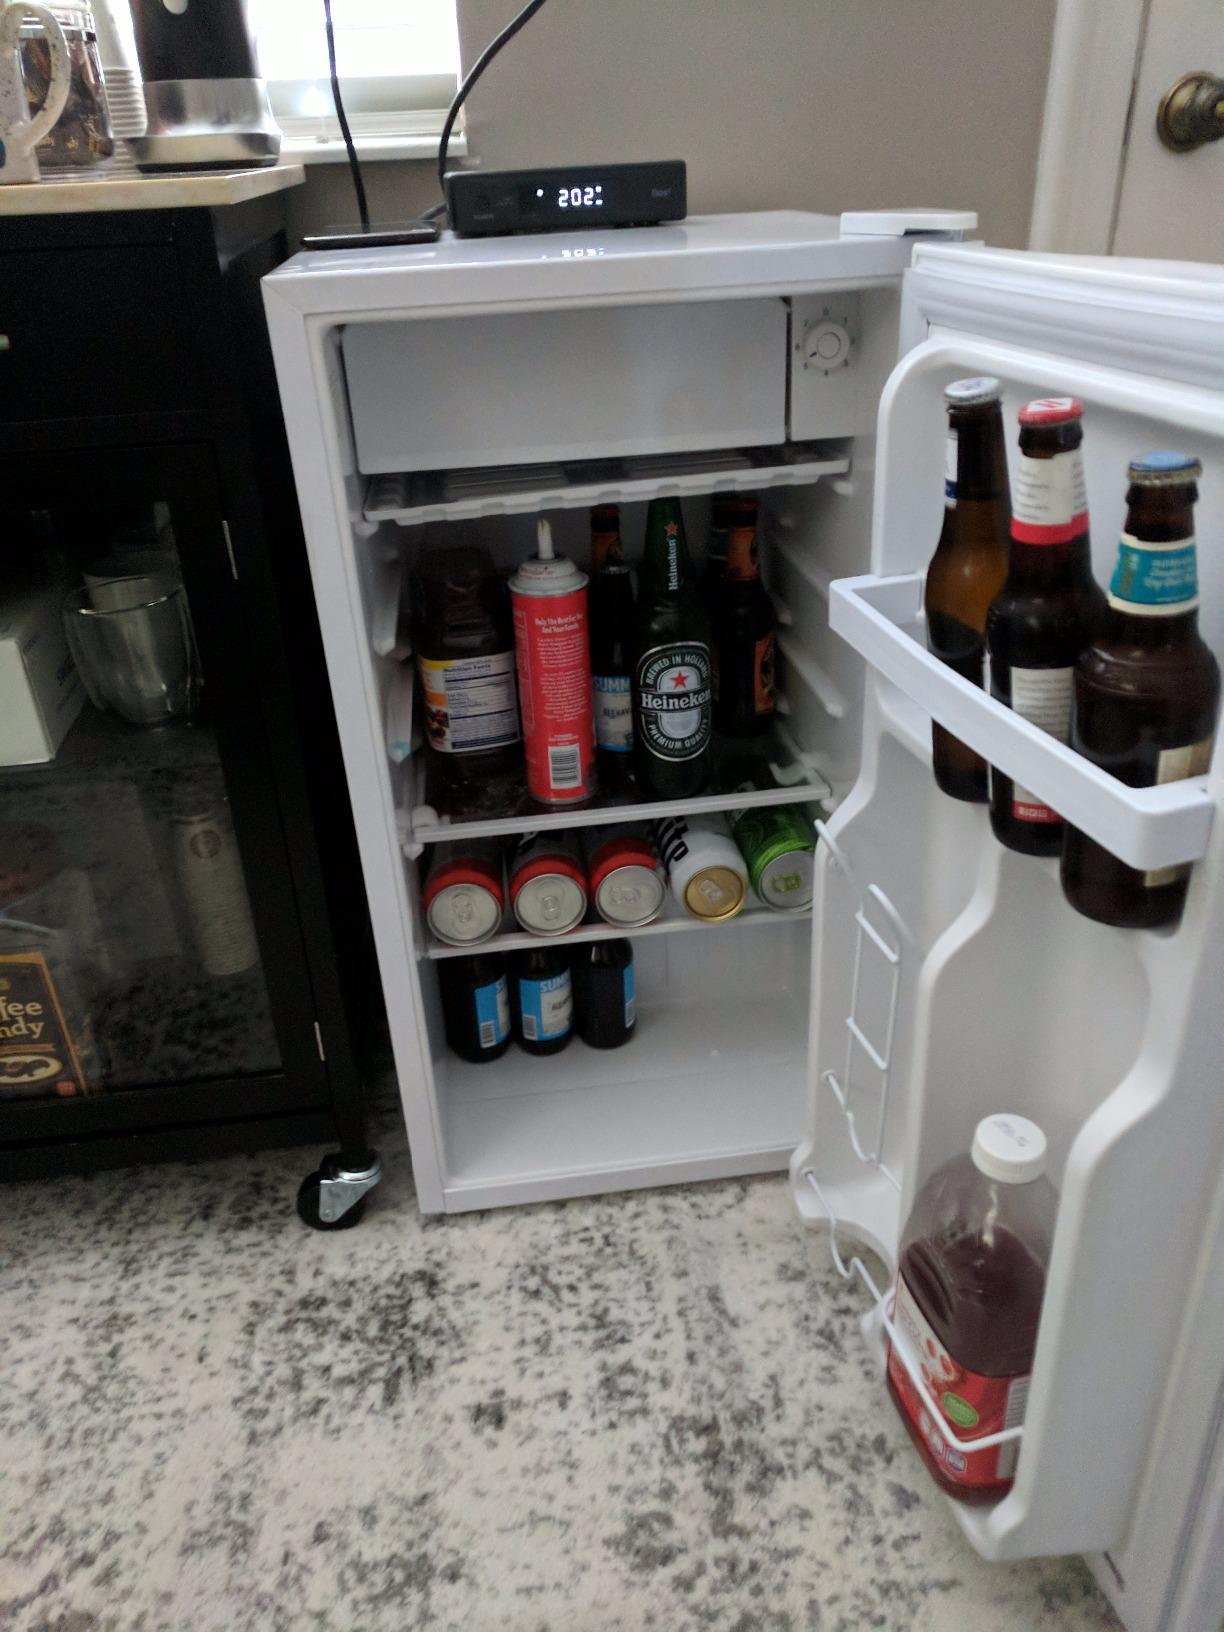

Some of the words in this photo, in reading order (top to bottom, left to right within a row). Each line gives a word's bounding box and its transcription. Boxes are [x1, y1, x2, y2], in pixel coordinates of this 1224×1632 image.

[646, 657, 670, 685] BREWED
[672, 654, 682, 665] IN
[641, 688, 711, 711] Heineken
[648, 723, 683, 749] PREMIUM
